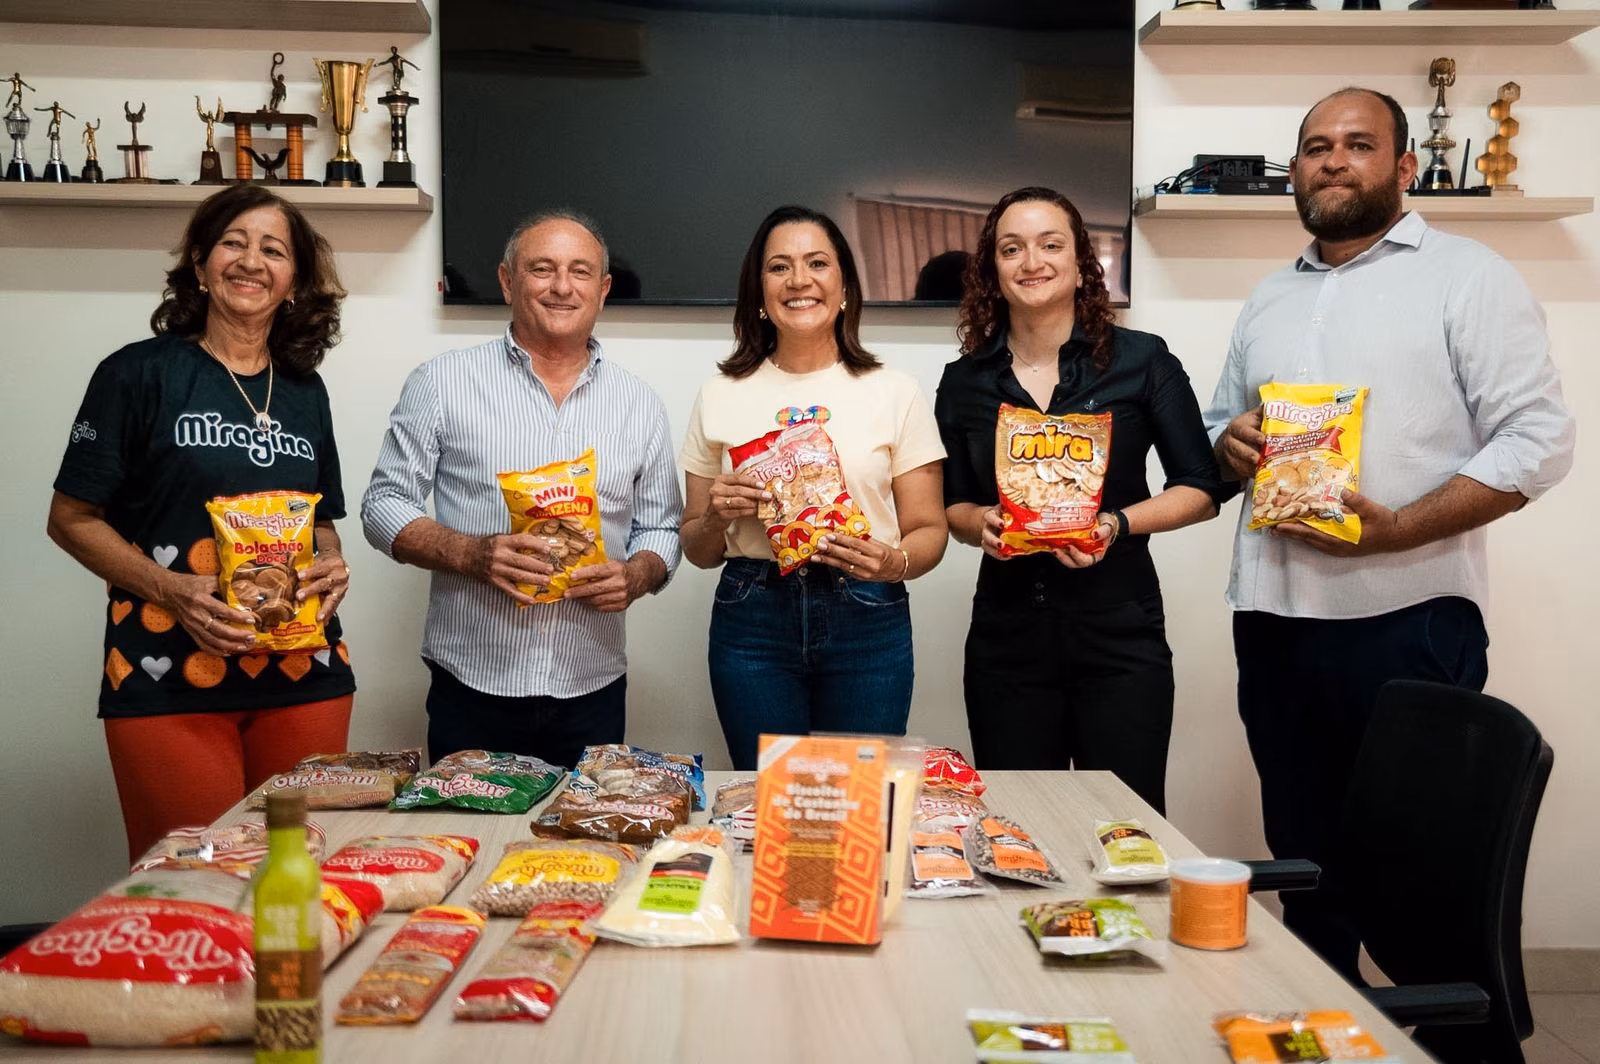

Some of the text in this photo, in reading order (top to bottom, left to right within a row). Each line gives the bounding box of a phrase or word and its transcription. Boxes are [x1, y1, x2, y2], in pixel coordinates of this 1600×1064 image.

[1264, 401, 1352, 431] Miragina
[175, 412, 315, 467] Miragina
[1008, 425, 1095, 463] mira
[535, 484, 575, 505] MINI
[224, 511, 309, 537] Miragina
[234, 539, 304, 555] Bolachão
[256, 554, 288, 565] Doce
[414, 772, 513, 798] Miragina
[795, 796, 860, 811] Castanha
[805, 809, 848, 822] Brasil
[28, 914, 234, 971] Miragina
